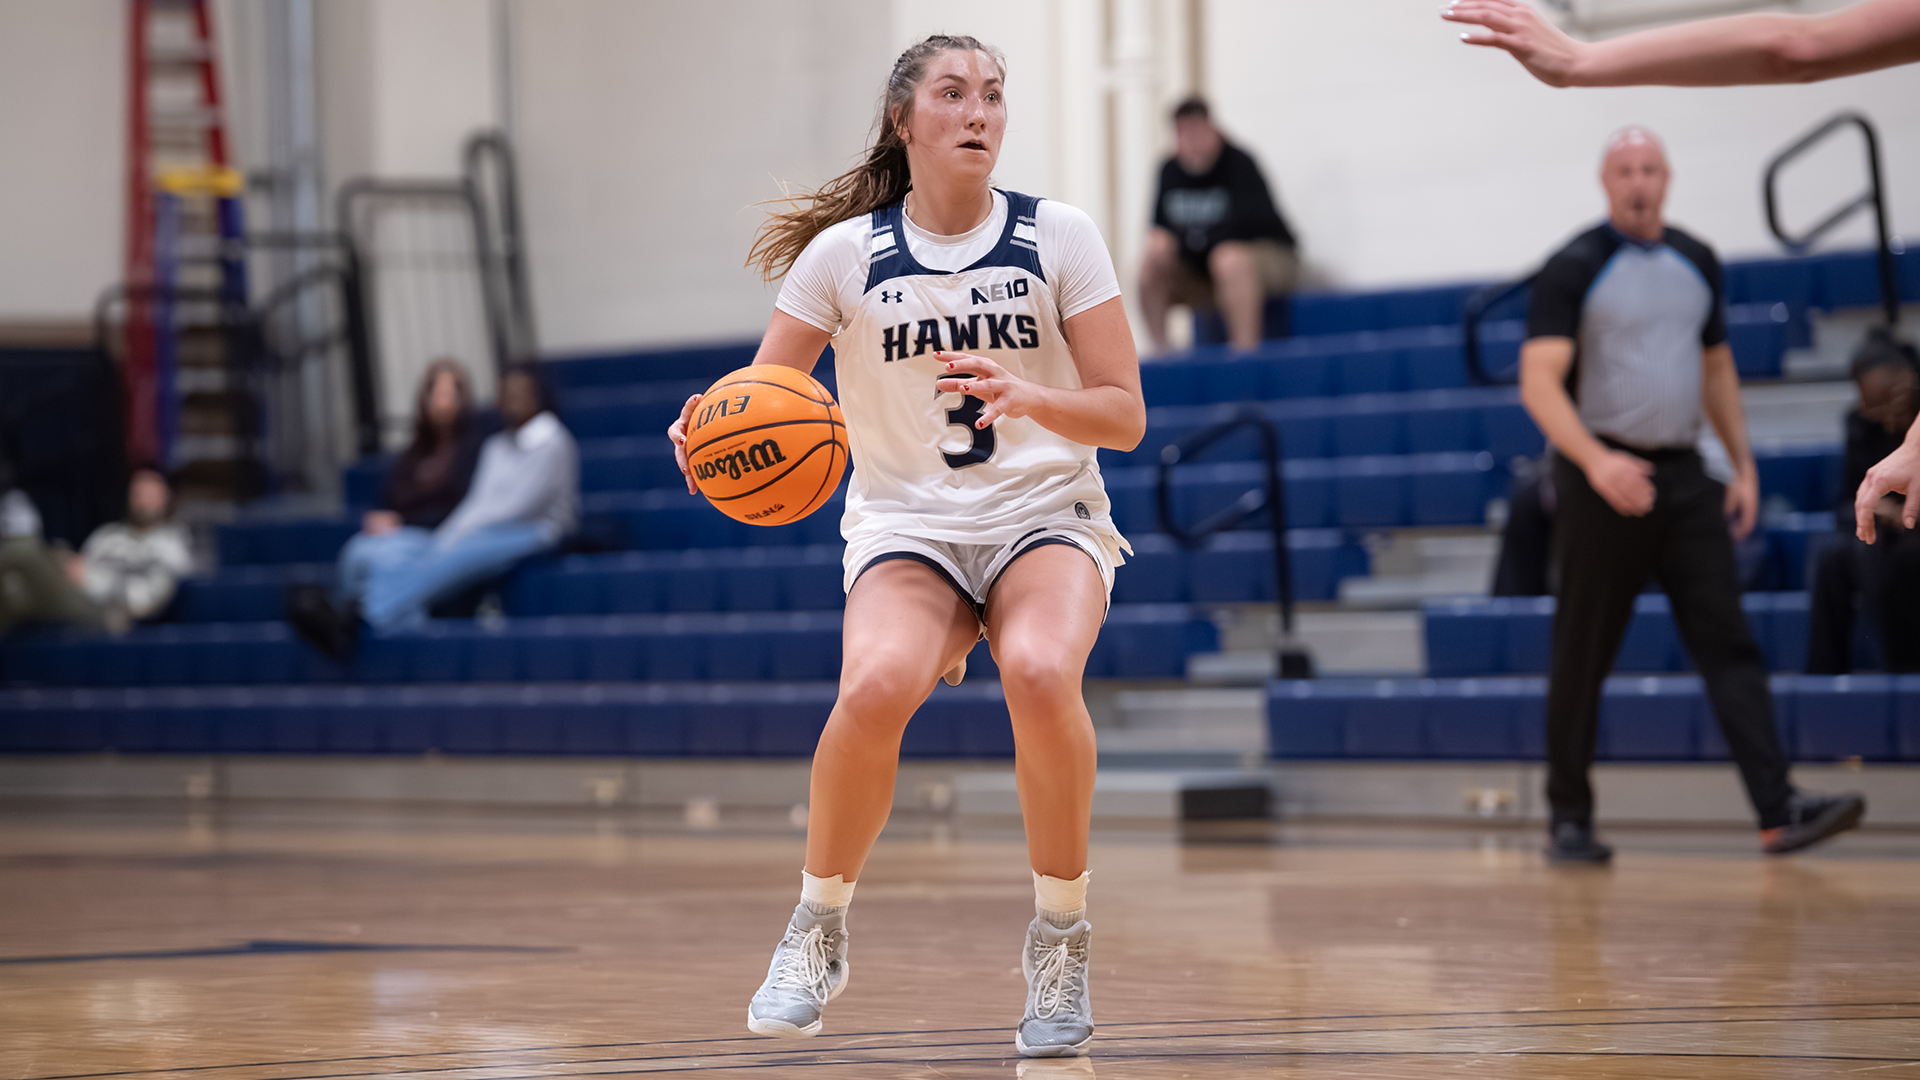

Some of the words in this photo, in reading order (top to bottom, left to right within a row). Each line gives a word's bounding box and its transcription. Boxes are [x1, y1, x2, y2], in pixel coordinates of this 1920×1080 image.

[971, 278, 1029, 305] NE10
[881, 313, 1040, 363] HAWKS
[697, 395, 751, 430] EVO
[933, 373, 997, 471] 3
[693, 439, 787, 481] Wilson
